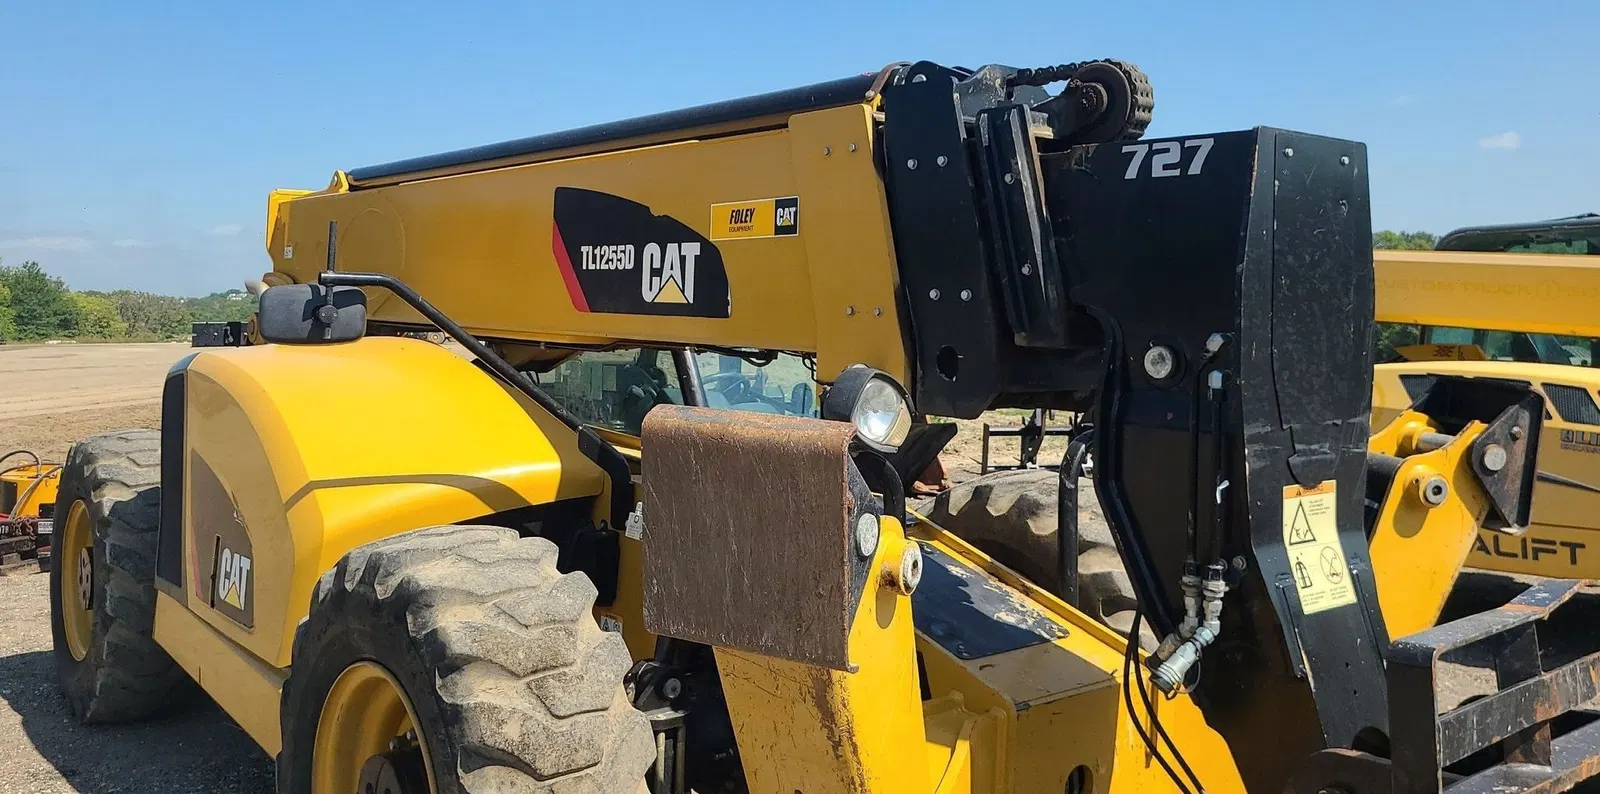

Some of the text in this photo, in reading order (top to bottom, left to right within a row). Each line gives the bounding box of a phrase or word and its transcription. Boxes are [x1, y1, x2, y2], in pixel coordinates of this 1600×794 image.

[1121, 137, 1215, 180] 727
[729, 207, 756, 225] FOLEY
[776, 206, 796, 227] CAT
[580, 243, 635, 271] TL1255D
[641, 242, 701, 304] CAT
[1470, 532, 1586, 566] ALIFT
[218, 547, 251, 611] CAT
